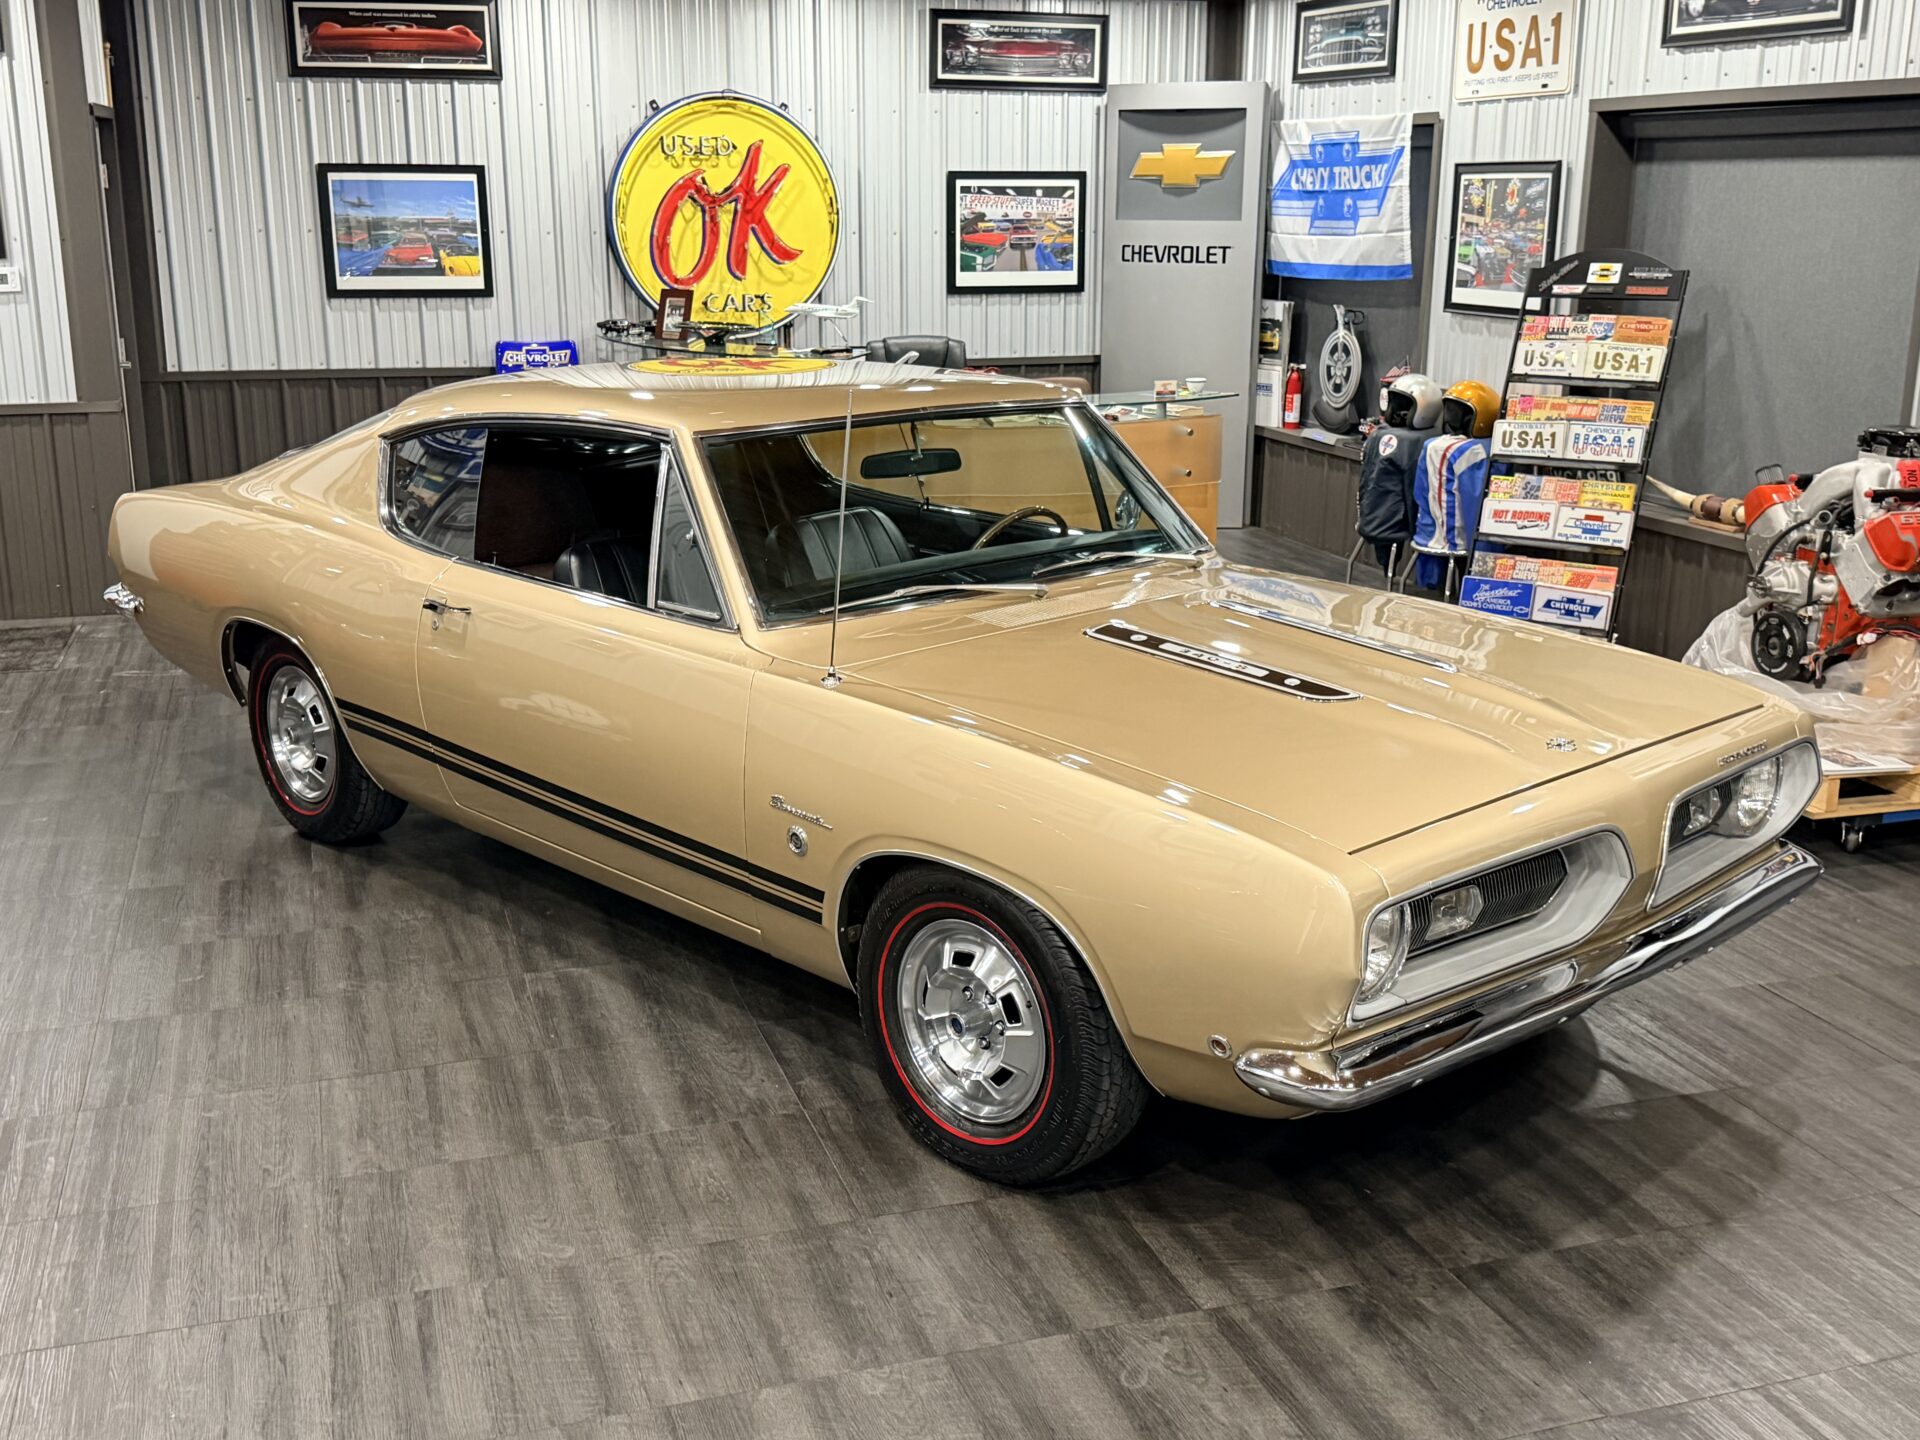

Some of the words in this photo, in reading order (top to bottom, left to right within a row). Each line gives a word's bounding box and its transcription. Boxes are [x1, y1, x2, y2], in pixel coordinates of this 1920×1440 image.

[660, 135, 735, 157] USED
[1291, 166, 1330, 190] CHEVY
[1333, 163, 1388, 189] TRUCKS
[649, 138, 803, 289] OK
[1121, 244, 1231, 264] CHEVROLET
[702, 293, 773, 314] CARS
[1622, 322, 1663, 330] CHEVROLET
[508, 353, 565, 362] CHEVROLET
[1600, 404, 1627, 414] SUPER
[1599, 413, 1625, 424] CHEVY
[1585, 426, 1626, 435] CHEVROLET
[1582, 482, 1626, 492] CHRYSLER
[1492, 509, 1511, 519] HOT
[1574, 519, 1612, 531] Chevrolet
[1483, 603, 1513, 611] CHEVROLET
[1550, 600, 1591, 613] CHEVROLET
